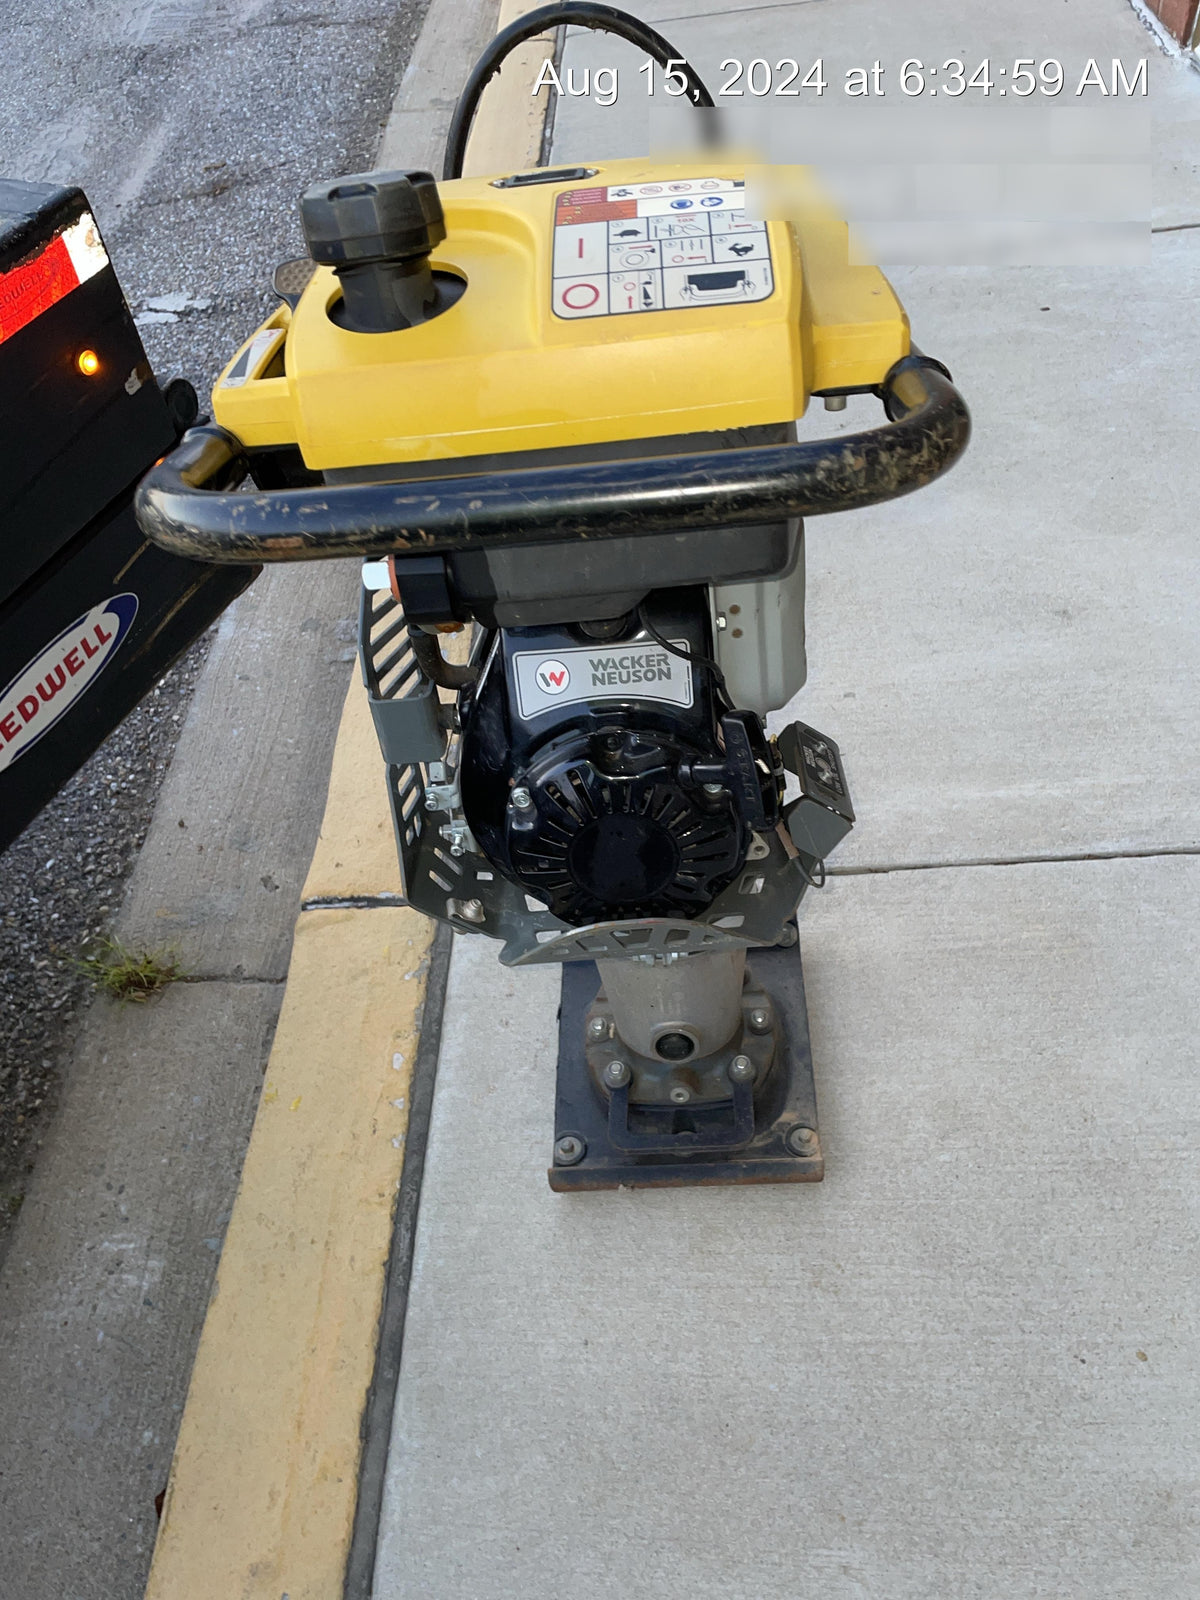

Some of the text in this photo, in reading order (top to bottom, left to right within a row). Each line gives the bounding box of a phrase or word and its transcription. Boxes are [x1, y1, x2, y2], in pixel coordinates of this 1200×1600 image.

[588, 653, 671, 672] WACKER
[591, 667, 672, 686] NEUSON
[0, 623, 113, 752] EDWELL
